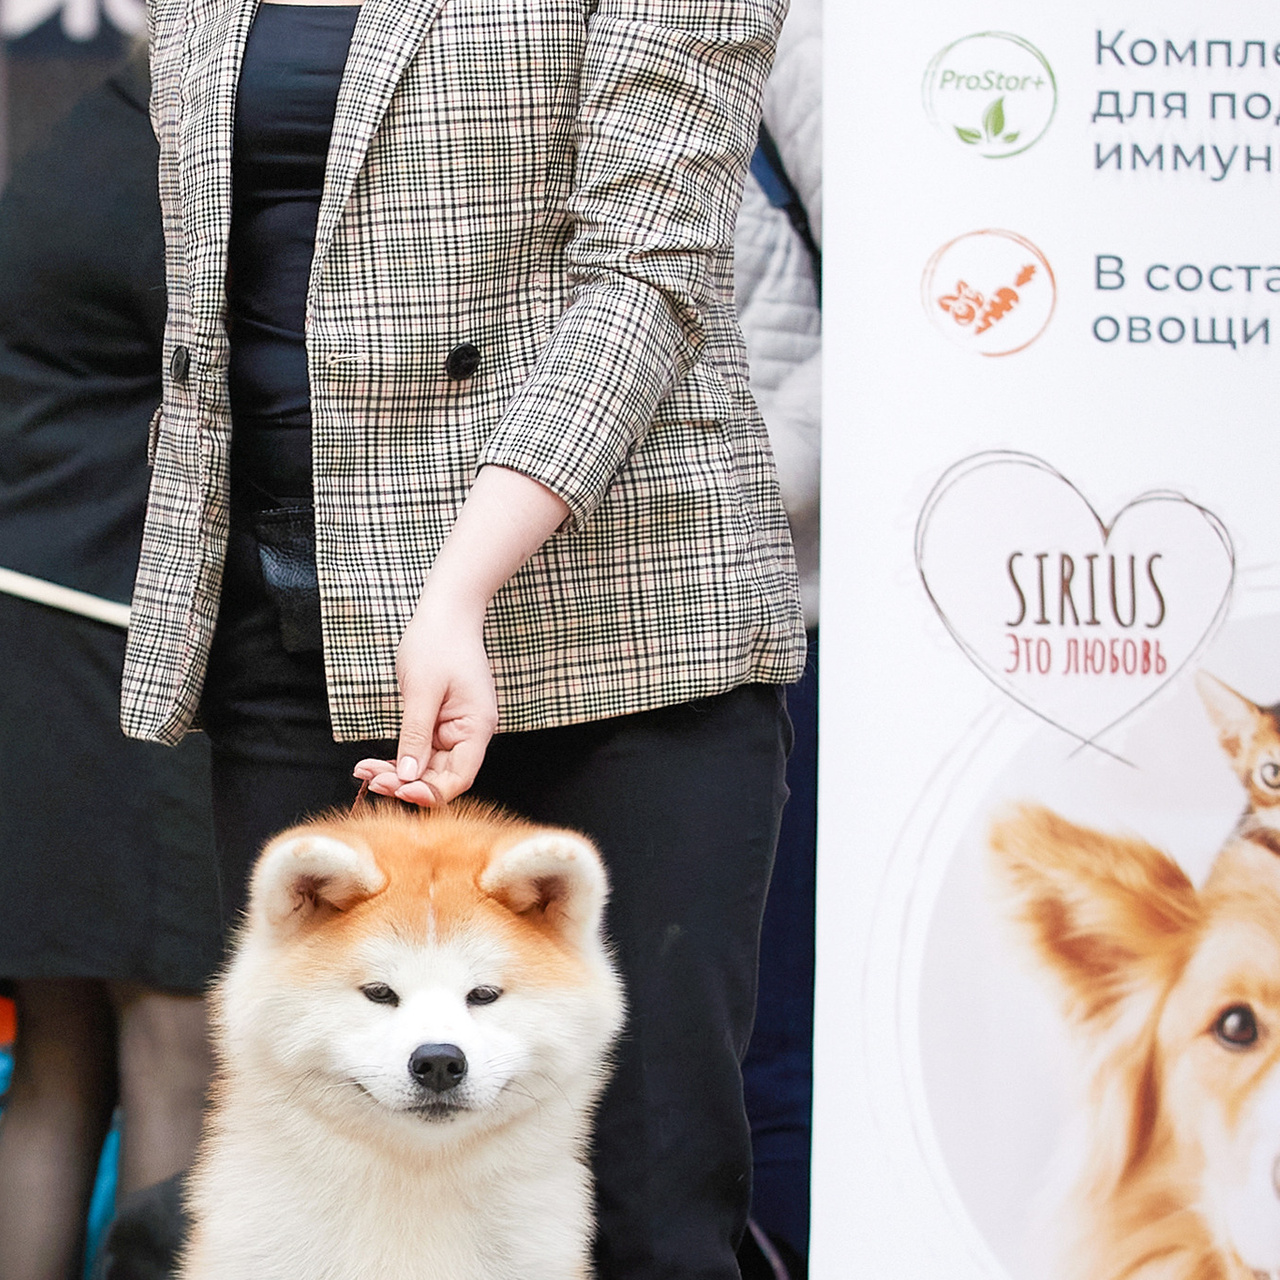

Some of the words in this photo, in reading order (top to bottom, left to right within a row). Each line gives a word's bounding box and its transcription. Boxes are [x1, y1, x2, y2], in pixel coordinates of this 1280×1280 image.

[1095, 28, 1280, 70] Компл
[939, 68, 1045, 93] ProStor+
[1091, 90, 1188, 124] для
[1210, 92, 1280, 126] по
[1094, 142, 1278, 182] иммун
[1095, 254, 1126, 291] В
[1093, 315, 1270, 350] овощи
[1005, 552, 1166, 629] SIRIUS
[1005, 633, 1052, 674] ЭТО
[1063, 637, 1167, 676] ЛЮБОВЬ
